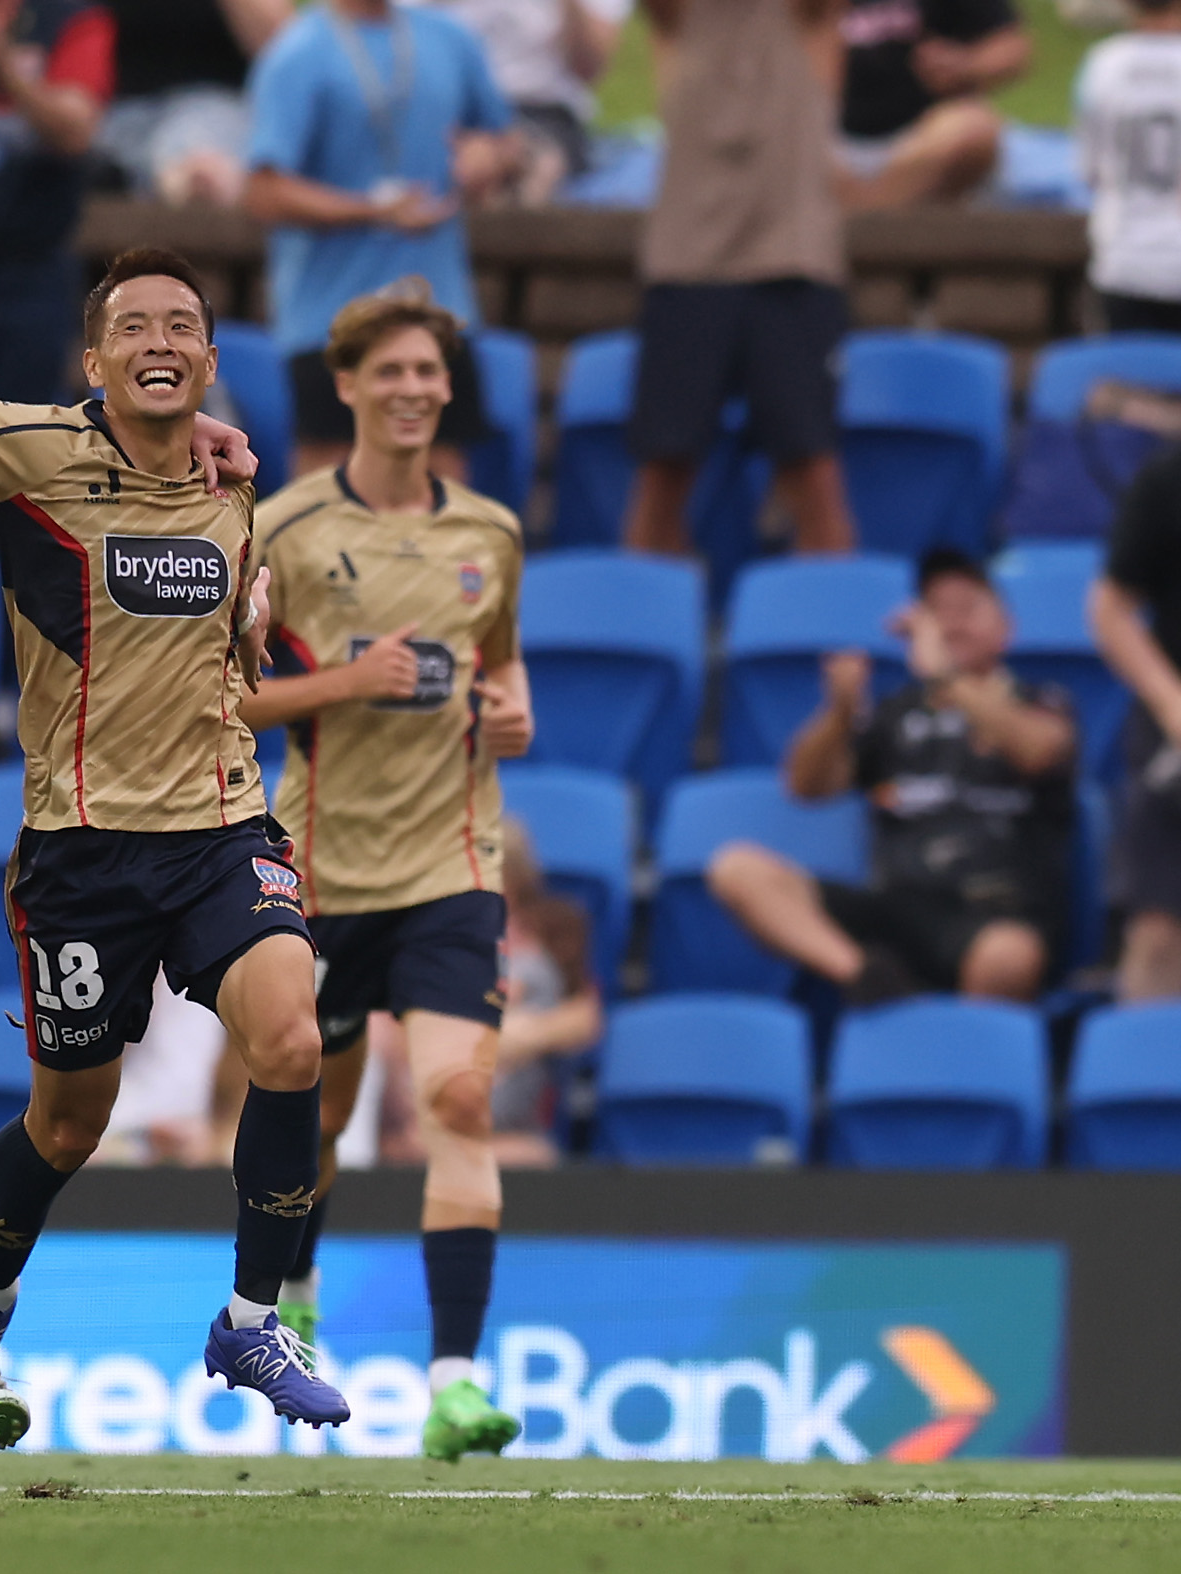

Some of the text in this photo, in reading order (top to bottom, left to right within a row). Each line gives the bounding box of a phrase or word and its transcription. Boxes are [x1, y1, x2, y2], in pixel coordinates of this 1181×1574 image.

[114, 549, 220, 586] brydens
[156, 580, 220, 603] lawyers
[29, 936, 105, 1011] 18
[60, 1018, 110, 1047] Eggy
